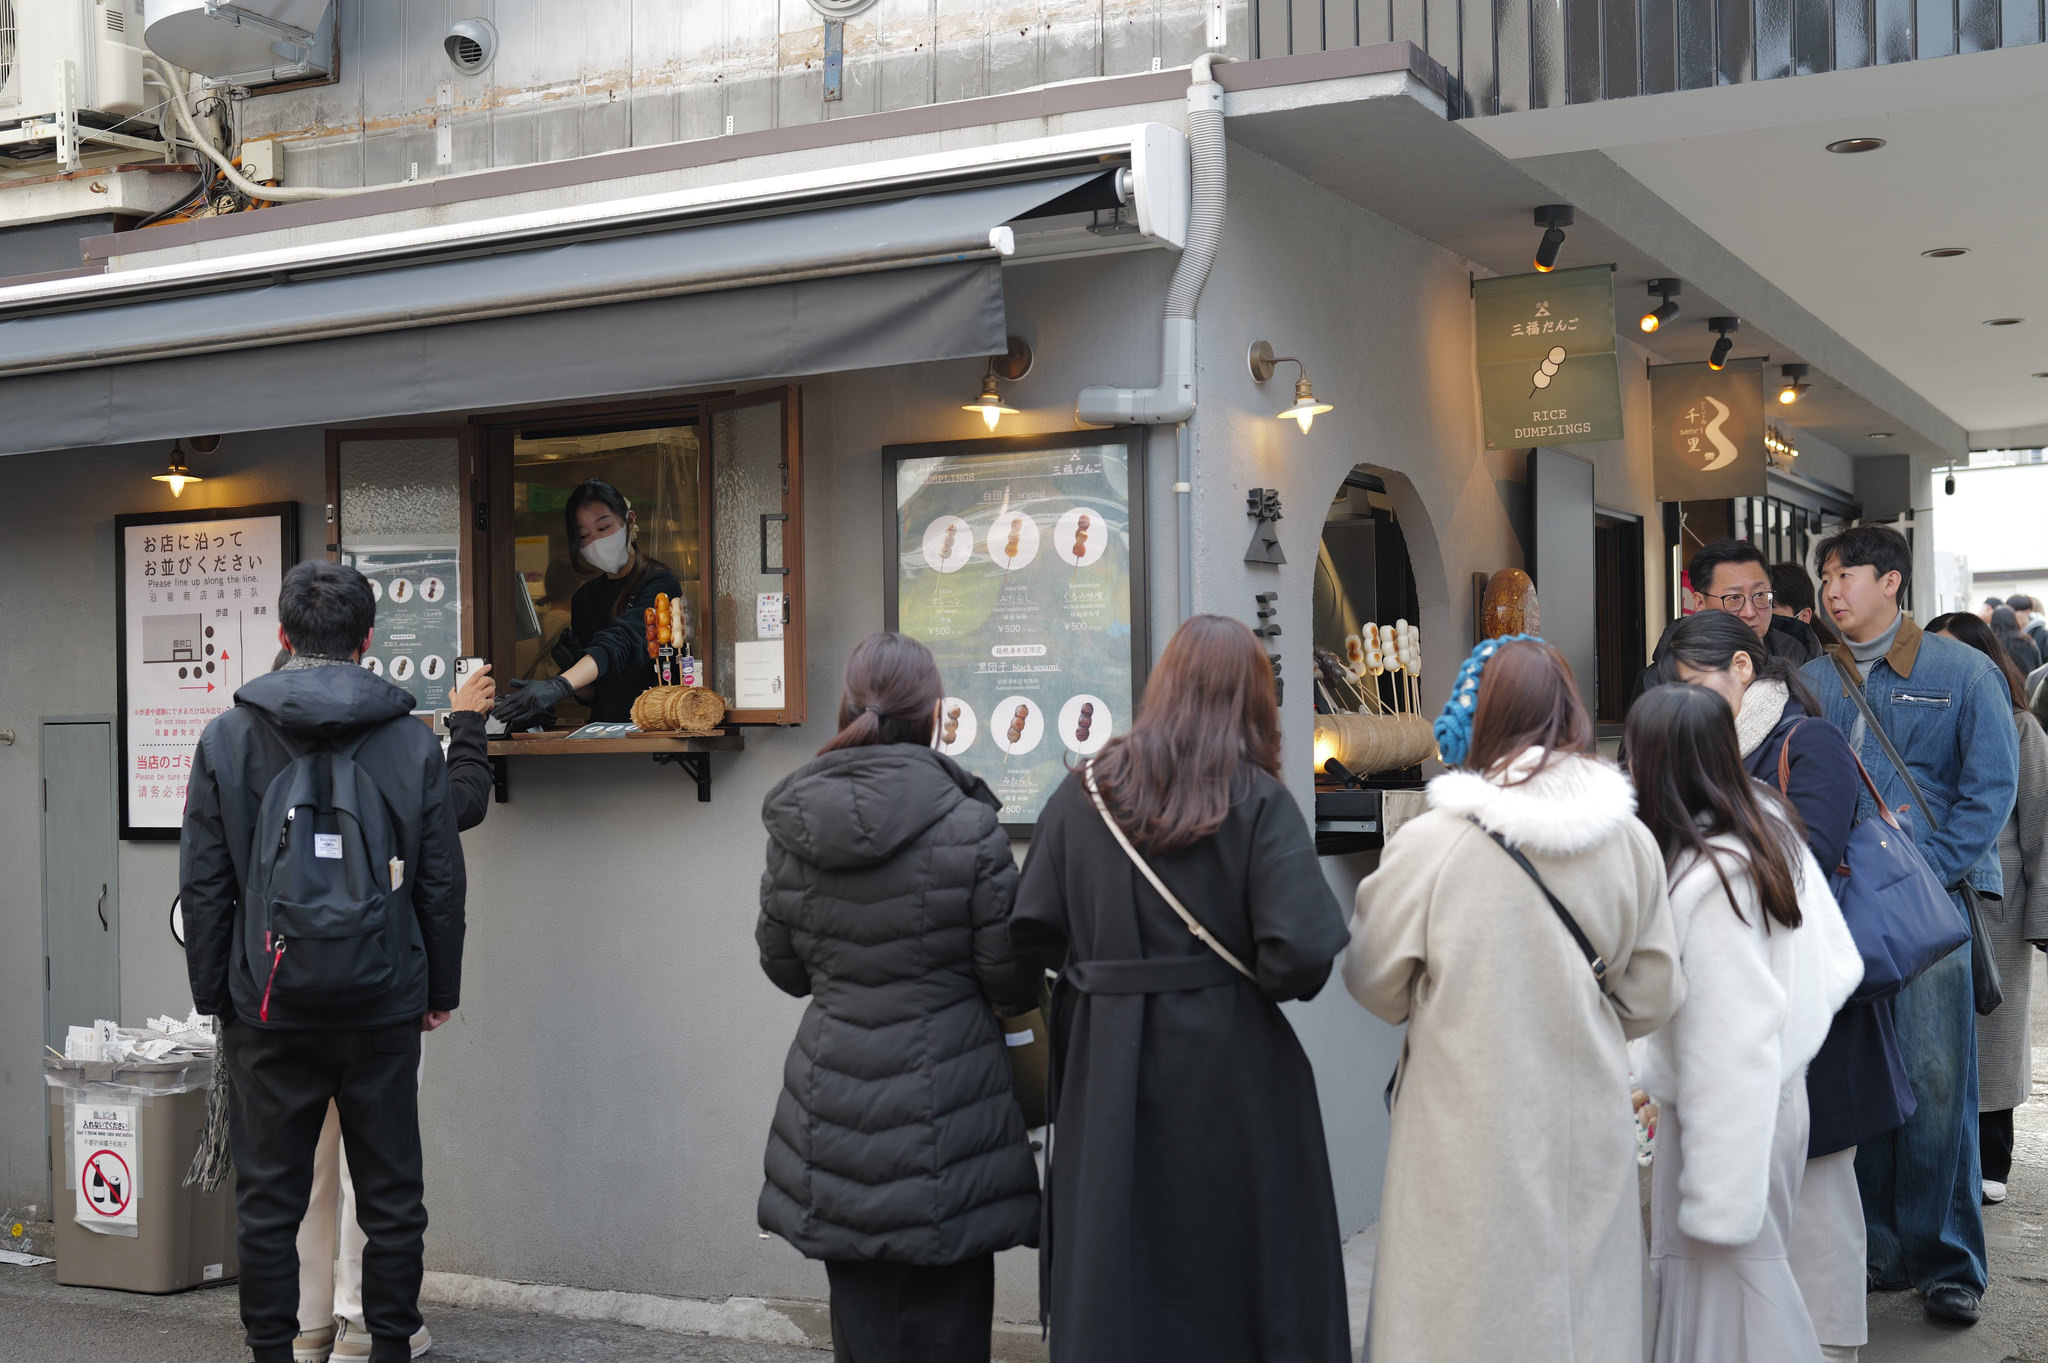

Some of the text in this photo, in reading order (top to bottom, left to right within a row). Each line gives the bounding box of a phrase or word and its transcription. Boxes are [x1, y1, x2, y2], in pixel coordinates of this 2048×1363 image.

[1511, 317, 1579, 337] 三福だんご
[1532, 409, 1567, 422] RICE
[1514, 422, 1591, 439] DUMPLINGS
[1679, 426, 1705, 436] senri
[1017, 489, 1046, 500] original
[144, 531, 243, 553] お店に沿って
[144, 554, 263, 577] お並びください
[148, 574, 259, 591] Please line up along the line.
[1012, 663, 1032, 672] black
[175, 718, 187, 726] step
[135, 772, 155, 781] Please
[157, 773, 166, 781] be
[167, 773, 180, 781] sure
